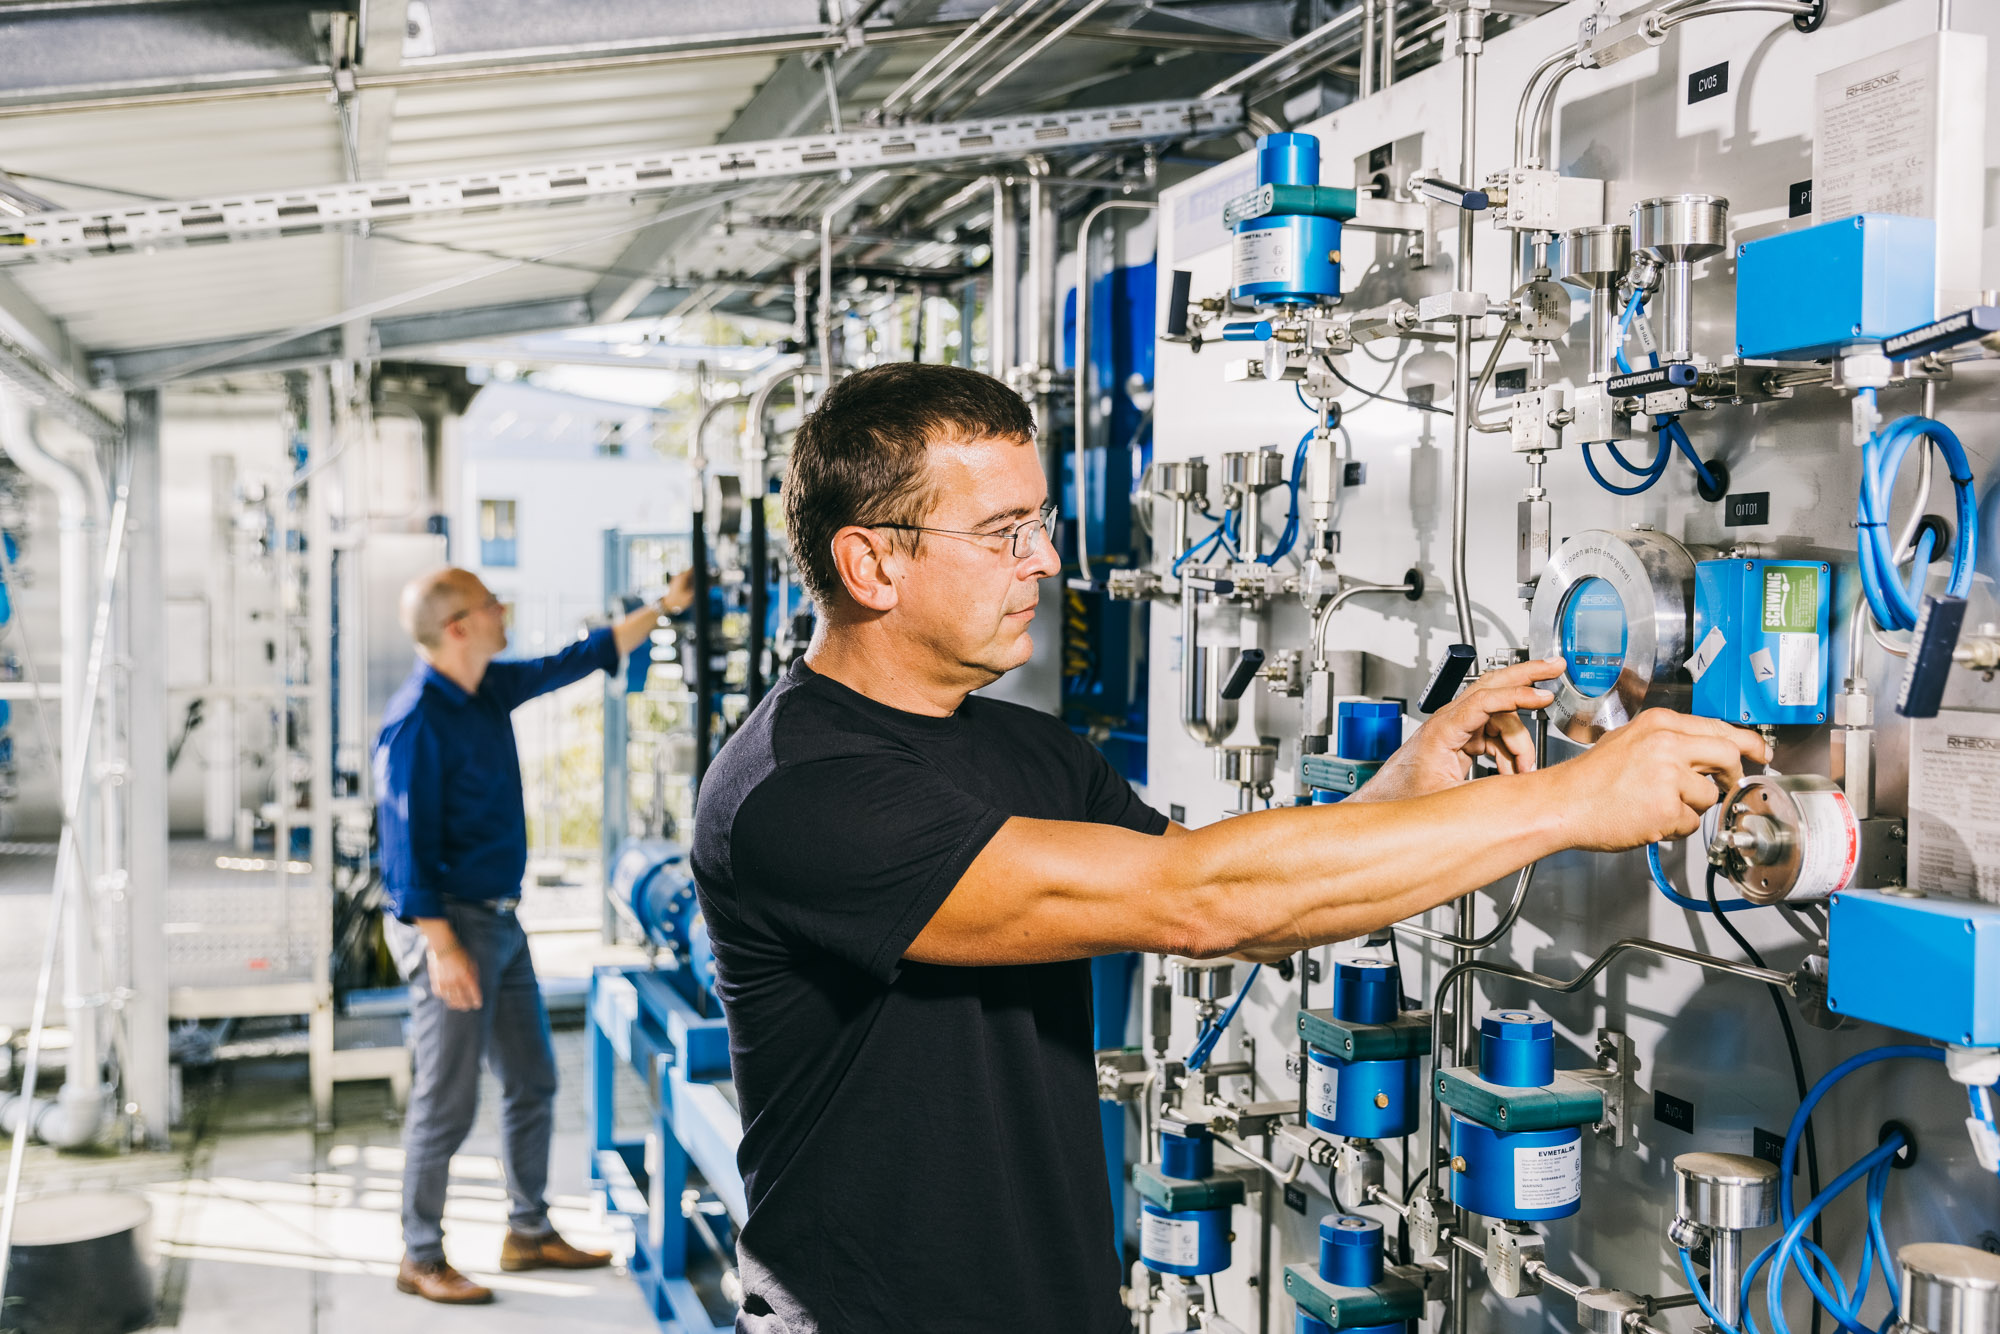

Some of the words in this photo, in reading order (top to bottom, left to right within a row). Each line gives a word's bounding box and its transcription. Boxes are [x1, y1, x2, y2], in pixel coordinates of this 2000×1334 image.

[1698, 74, 1718, 92] CV05
[1846, 73, 1900, 98] RHEONIK
[1886, 314, 1969, 353] MAXIMATOR
[1608, 370, 1665, 391] MAXIMATOR
[1568, 549, 1584, 563] open
[1584, 545, 1602, 555] when
[1765, 572, 1782, 627] SCHWING
[1538, 1144, 1576, 1157] EVMETAL.DK
